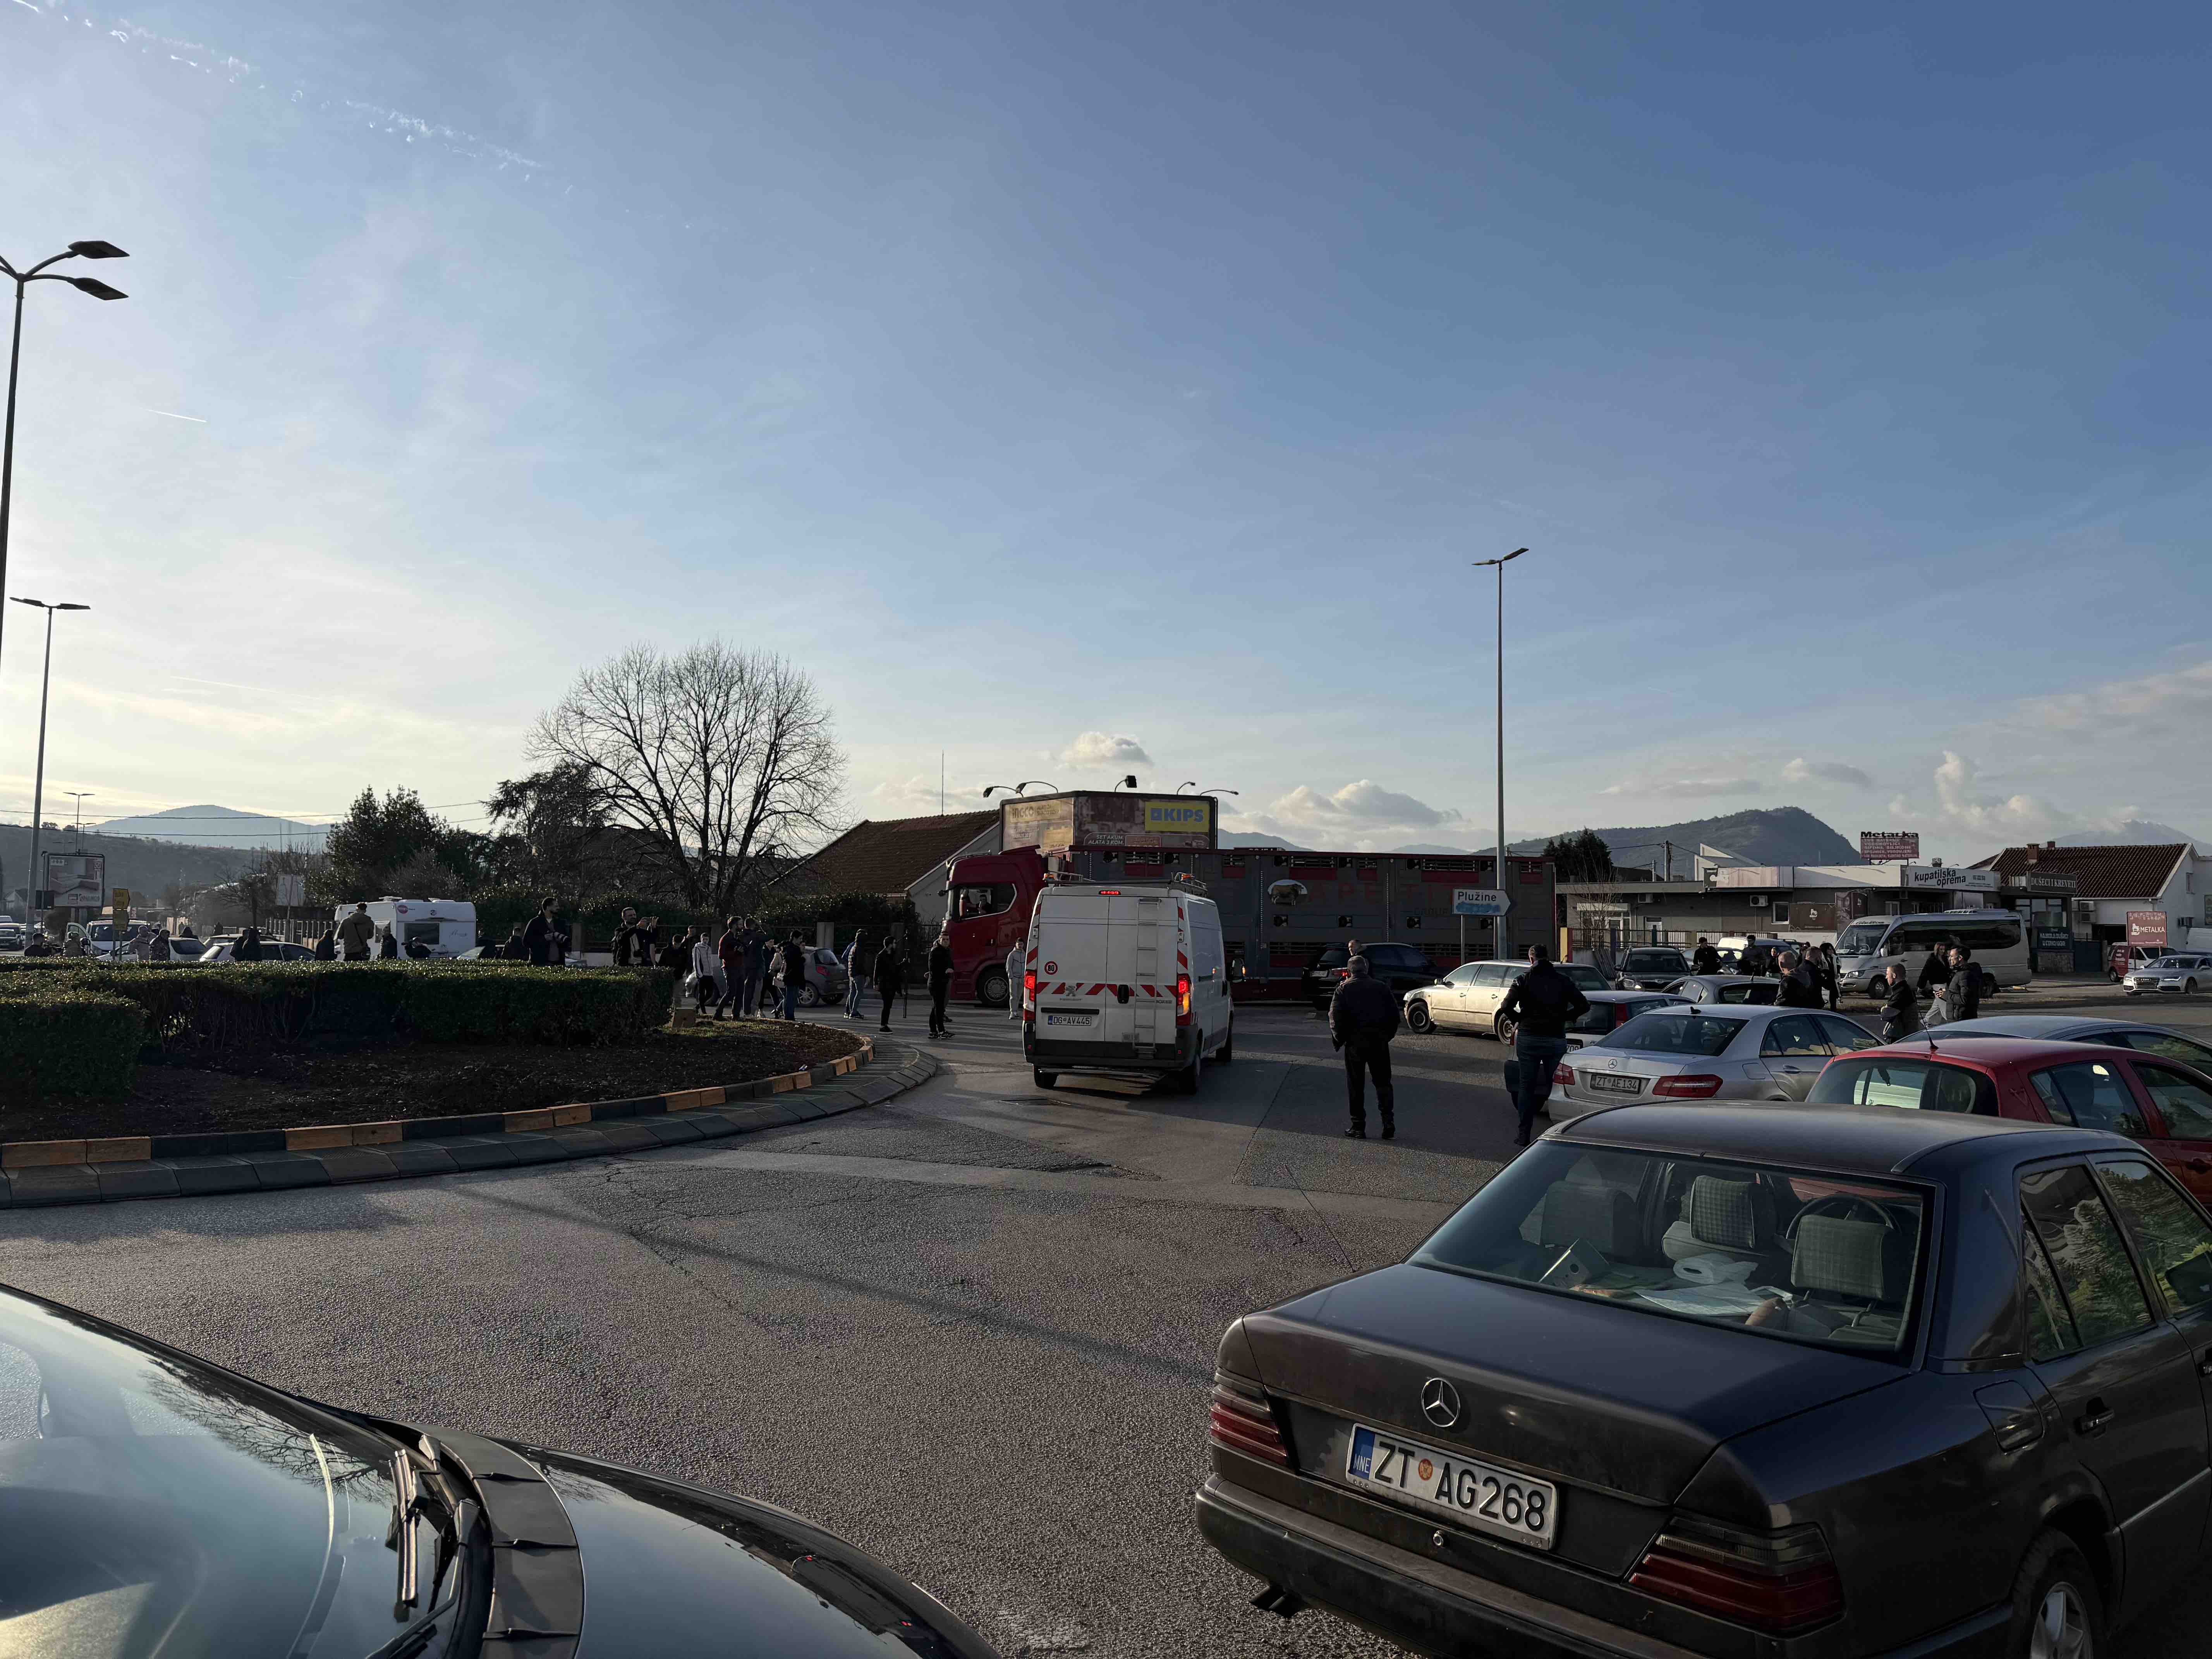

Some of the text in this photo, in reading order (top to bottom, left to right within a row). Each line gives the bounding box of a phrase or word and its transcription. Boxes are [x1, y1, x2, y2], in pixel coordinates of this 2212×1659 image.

[1164, 808, 1203, 822] KIPS
[1914, 868, 1956, 883] kupatilska
[1937, 875, 1966, 888] oprema
[2031, 876, 2050, 886] DUŠECI
[2054, 879, 2076, 888] KREVETI
[1458, 891, 1497, 902] Plužine
[1597, 1077, 1637, 1090] ZT AE134
[1354, 1453, 1371, 1473] MNE
[1374, 1441, 1545, 1531] ZT AG268
